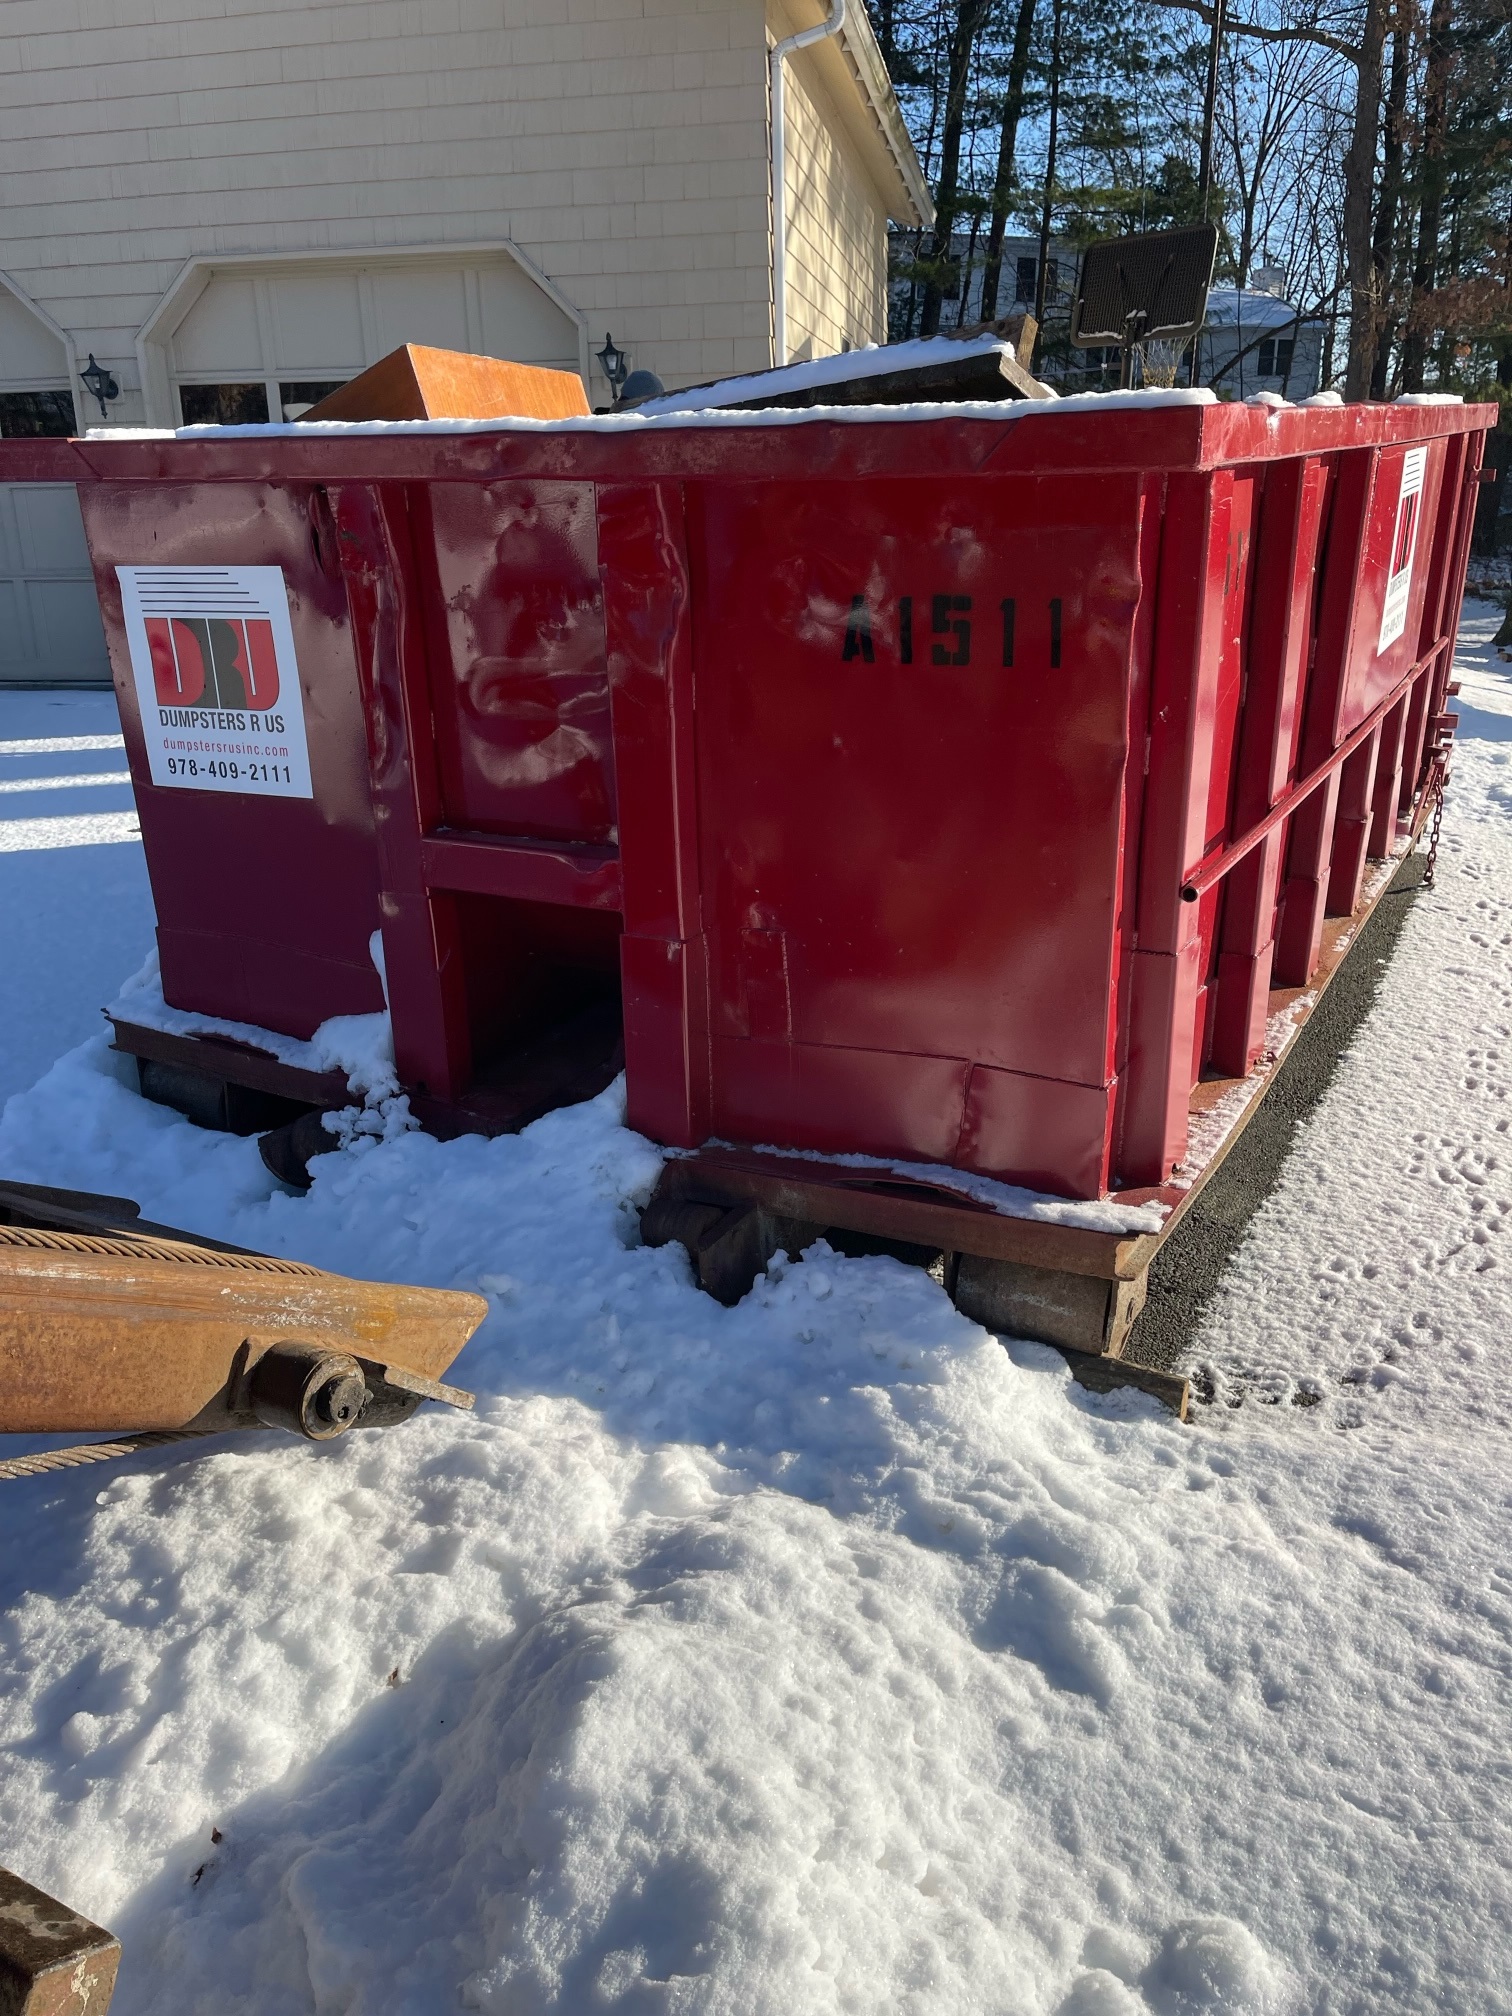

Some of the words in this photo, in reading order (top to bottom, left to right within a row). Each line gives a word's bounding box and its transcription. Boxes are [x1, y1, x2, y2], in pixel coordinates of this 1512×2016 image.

[842, 594, 1062, 668] A1511
[159, 709, 246, 730] DUMPSTERS
[250, 714, 261, 732] R
[264, 714, 285, 733] US
[163, 737, 289, 757] dumpstersrusinc.com
[168, 758, 291, 783] 978-409-2111
